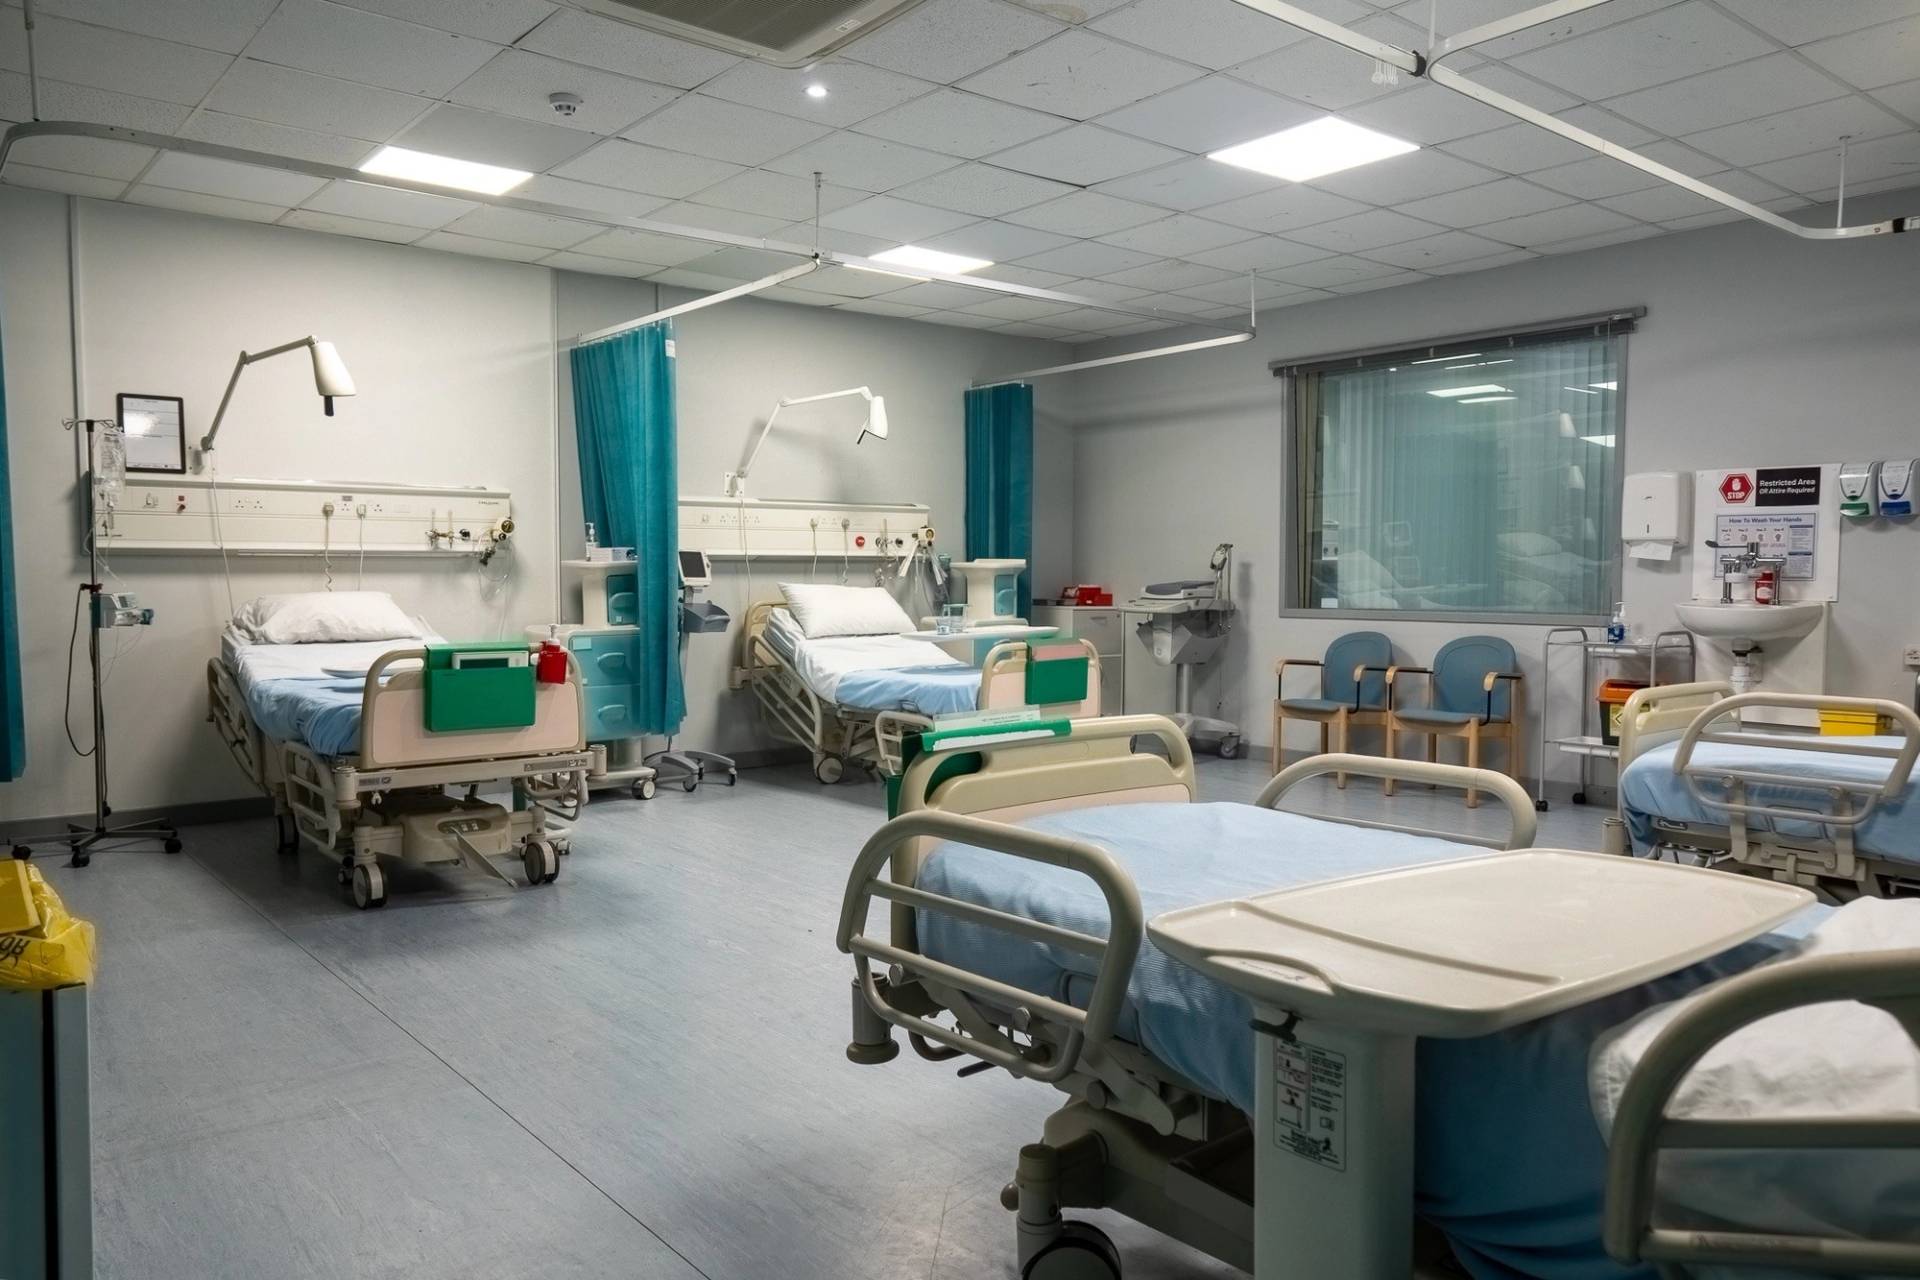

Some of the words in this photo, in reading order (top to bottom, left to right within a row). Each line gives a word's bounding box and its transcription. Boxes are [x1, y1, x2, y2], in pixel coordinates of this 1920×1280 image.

[1759, 479, 1796, 487] Restricted
[1797, 478, 1816, 486] Area
[1786, 486, 1815, 494] Required
[1727, 491, 1745, 500] STOP
